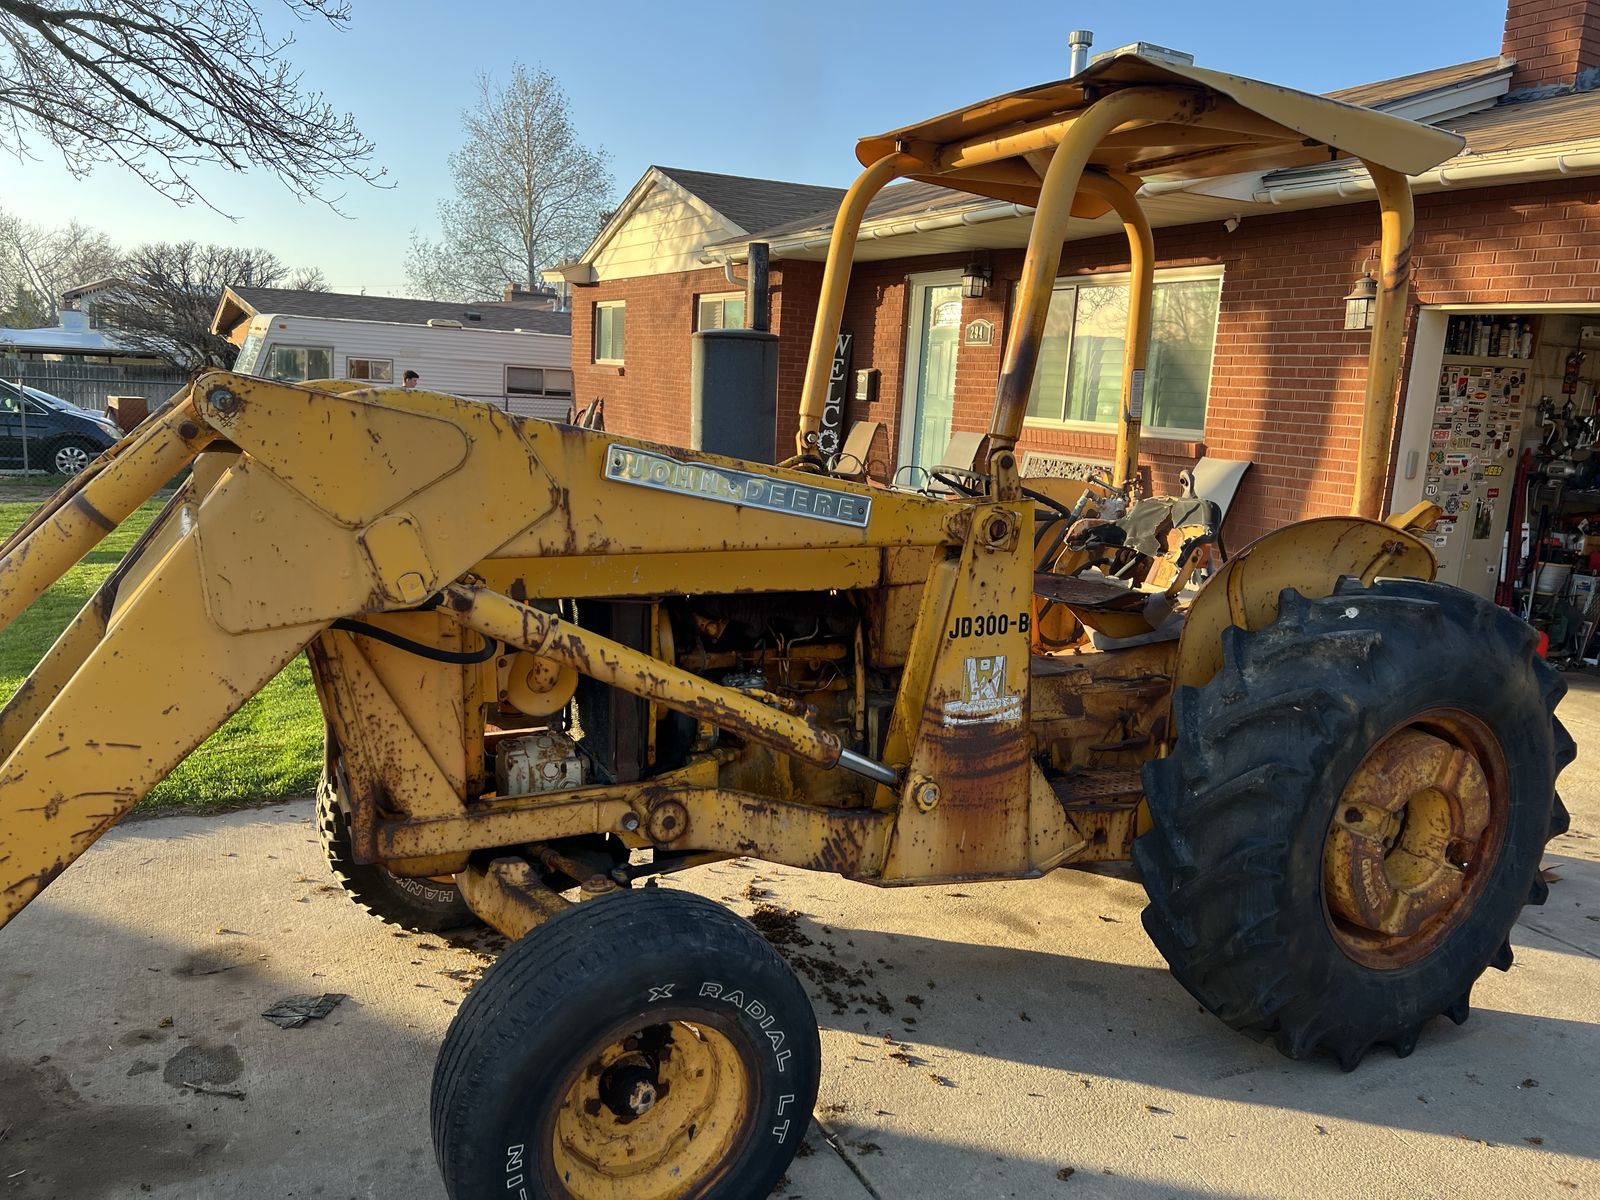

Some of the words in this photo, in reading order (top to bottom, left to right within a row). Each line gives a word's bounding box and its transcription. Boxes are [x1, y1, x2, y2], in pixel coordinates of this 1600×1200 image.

[970, 325, 984, 339] 294
[628, 459, 720, 495] JOHN
[744, 478, 855, 518] DEERE
[948, 612, 1030, 639] JD300-B
[649, 983, 676, 1002] X
[699, 982, 792, 1073] RADIAL
[772, 1094, 795, 1144] LT
